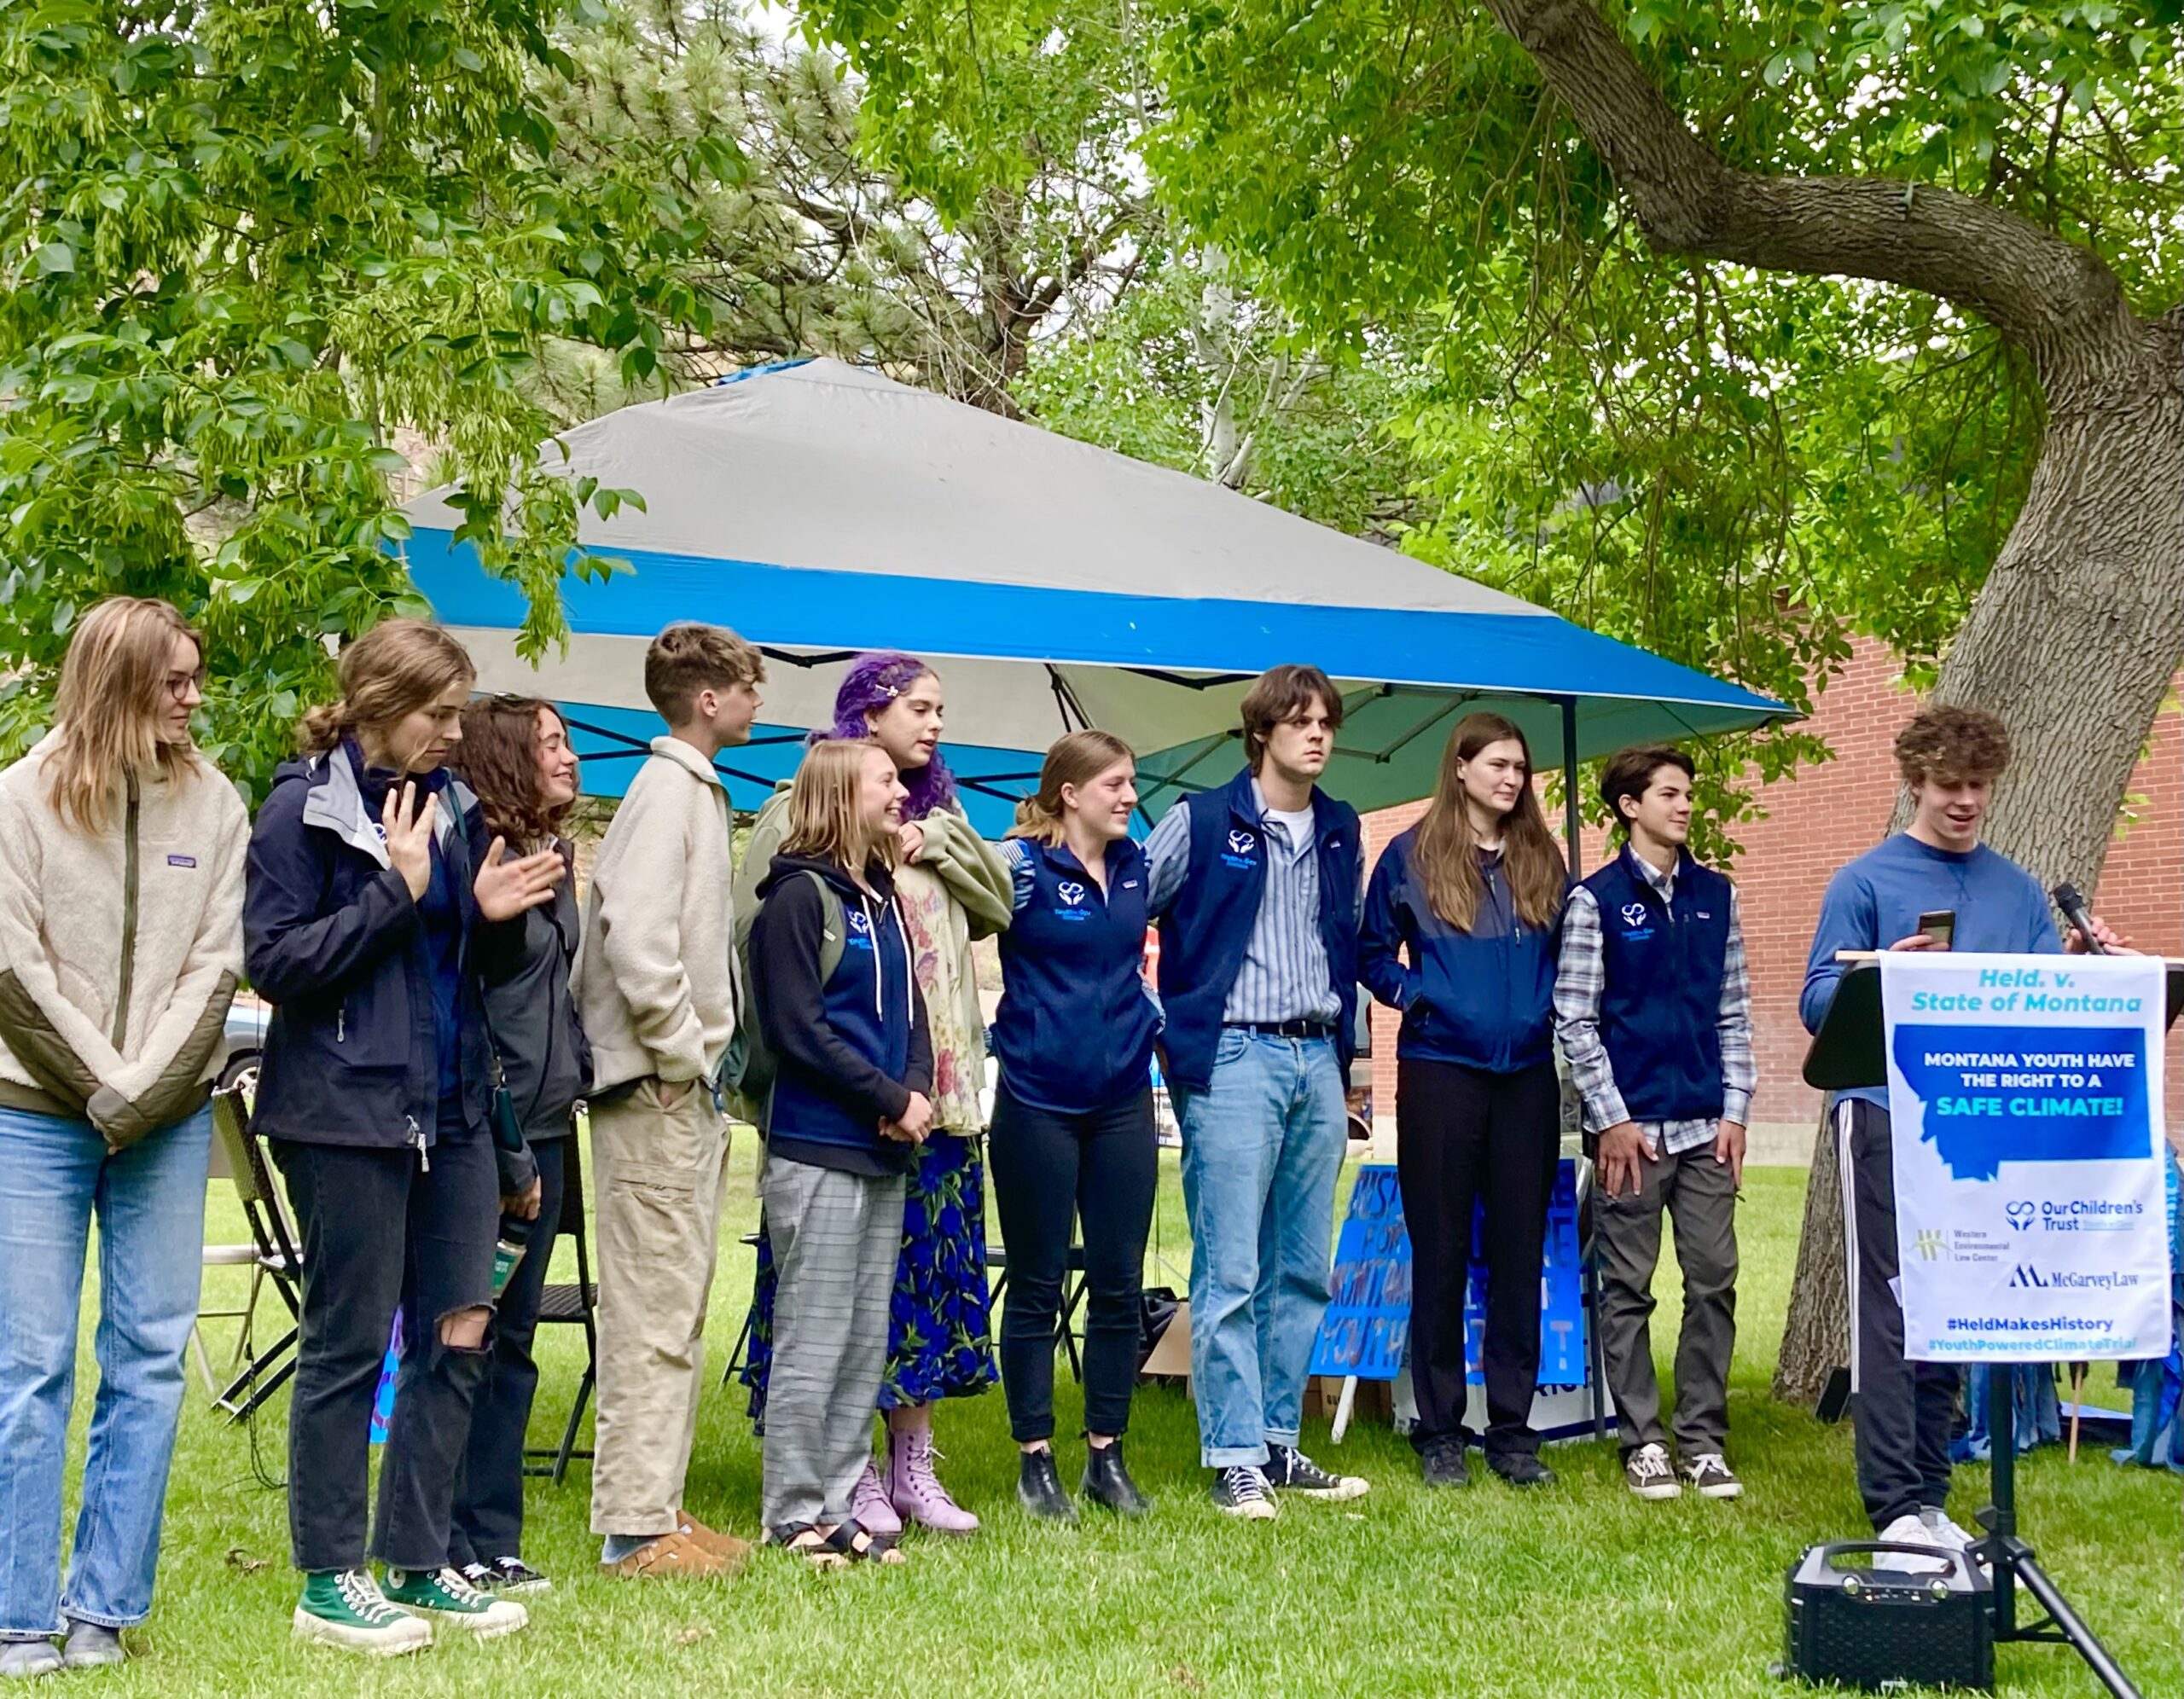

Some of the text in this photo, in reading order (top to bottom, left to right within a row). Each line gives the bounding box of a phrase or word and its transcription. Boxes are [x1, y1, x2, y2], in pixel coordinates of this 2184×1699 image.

[1978, 969, 2076, 987] Held. v.
[1910, 992, 2142, 1012] State of Montana
[1924, 1052, 2135, 1068] MONTANA YOUTH HAVE
[1960, 1073, 2102, 1087] THE RIGHT TO A
[1937, 1097, 2123, 1116] SAFE CLIMATE!
[2042, 1217, 2079, 1231] Trust
[1947, 1316, 2113, 1332] #HeldMakesHistory
[1320, 1317, 1409, 1368] YOUTH
[1928, 1337, 2137, 1352] #YouthPoweredClimateTrial
